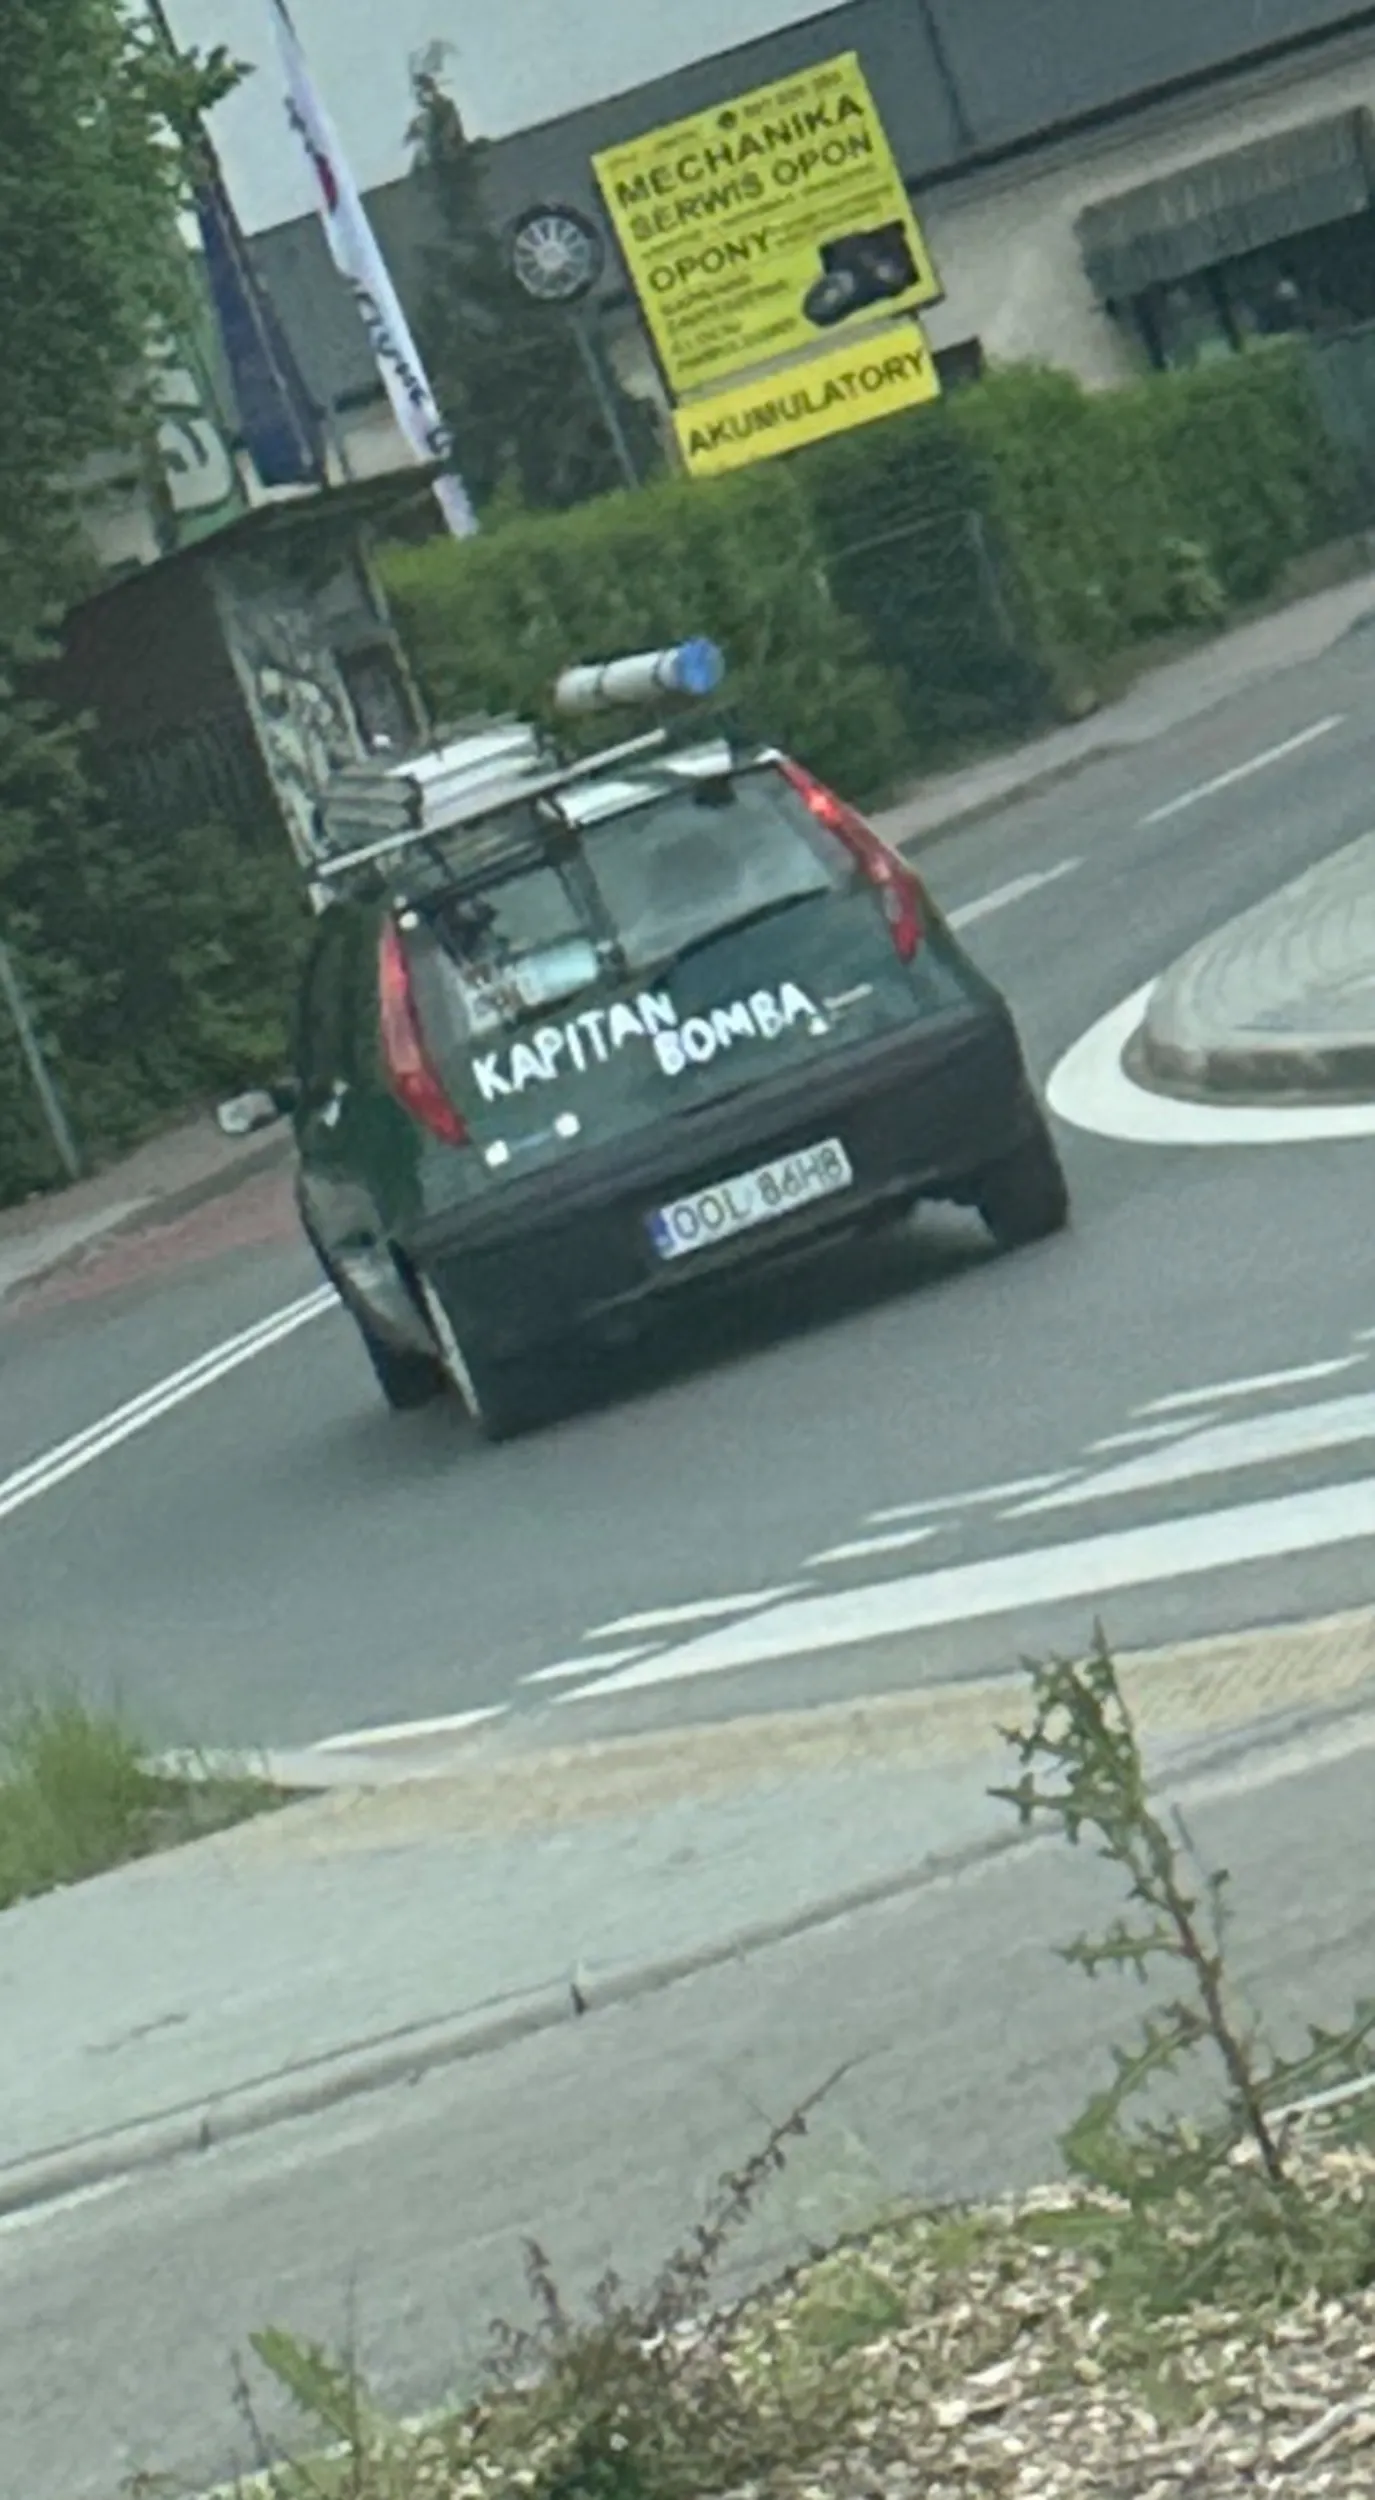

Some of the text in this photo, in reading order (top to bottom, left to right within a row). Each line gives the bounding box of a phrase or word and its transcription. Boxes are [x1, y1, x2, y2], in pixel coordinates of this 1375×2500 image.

[614, 93, 865, 211] MECHANIKA
[628, 171, 765, 243] SERWIS
[771, 131, 873, 187] OPON
[648, 227, 773, 293] OPONY
[687, 349, 927, 457] AKUMULATORY
[471, 991, 677, 1101] KAPITAN
[654, 982, 817, 1076] BOMBA
[670, 1195, 752, 1242] OOL
